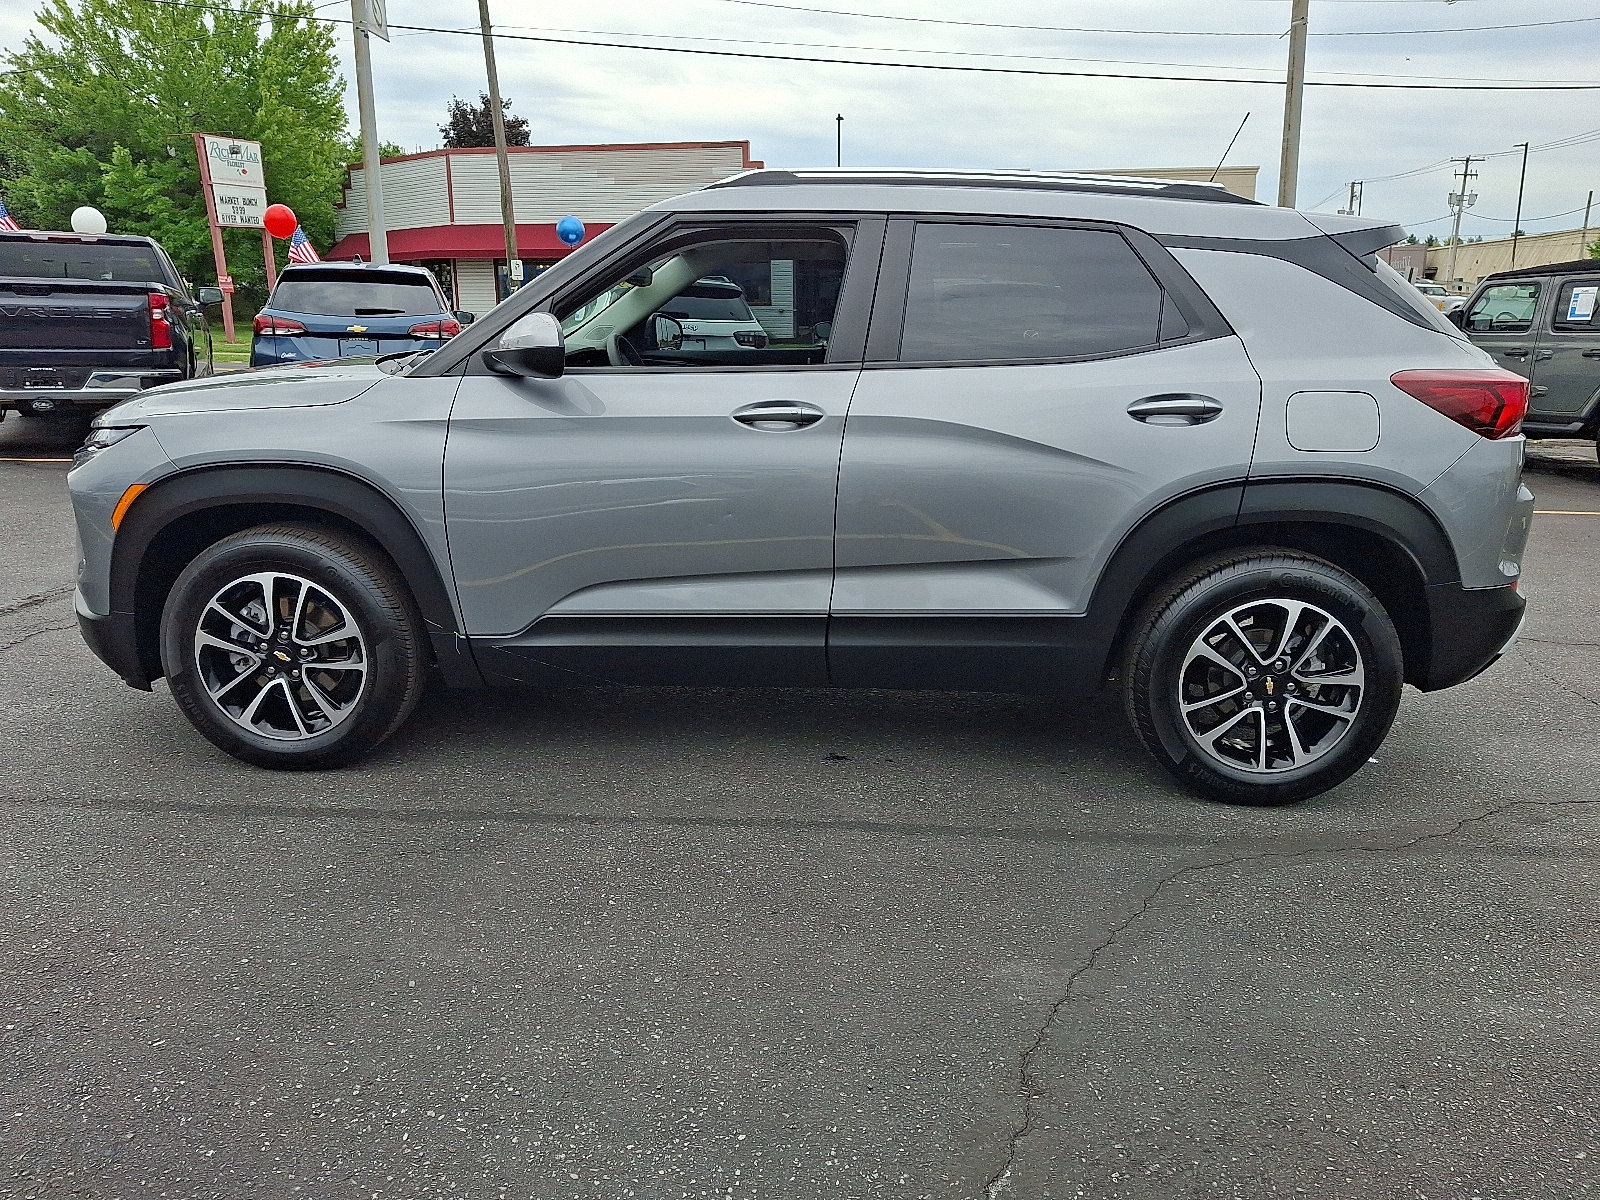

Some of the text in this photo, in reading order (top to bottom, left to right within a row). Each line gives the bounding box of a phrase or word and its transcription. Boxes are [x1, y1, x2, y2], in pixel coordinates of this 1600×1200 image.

[227, 160, 245, 168] FLORIST
[220, 196, 258, 206] MARKET BUNCH
[240, 216, 259, 224] WANTED
